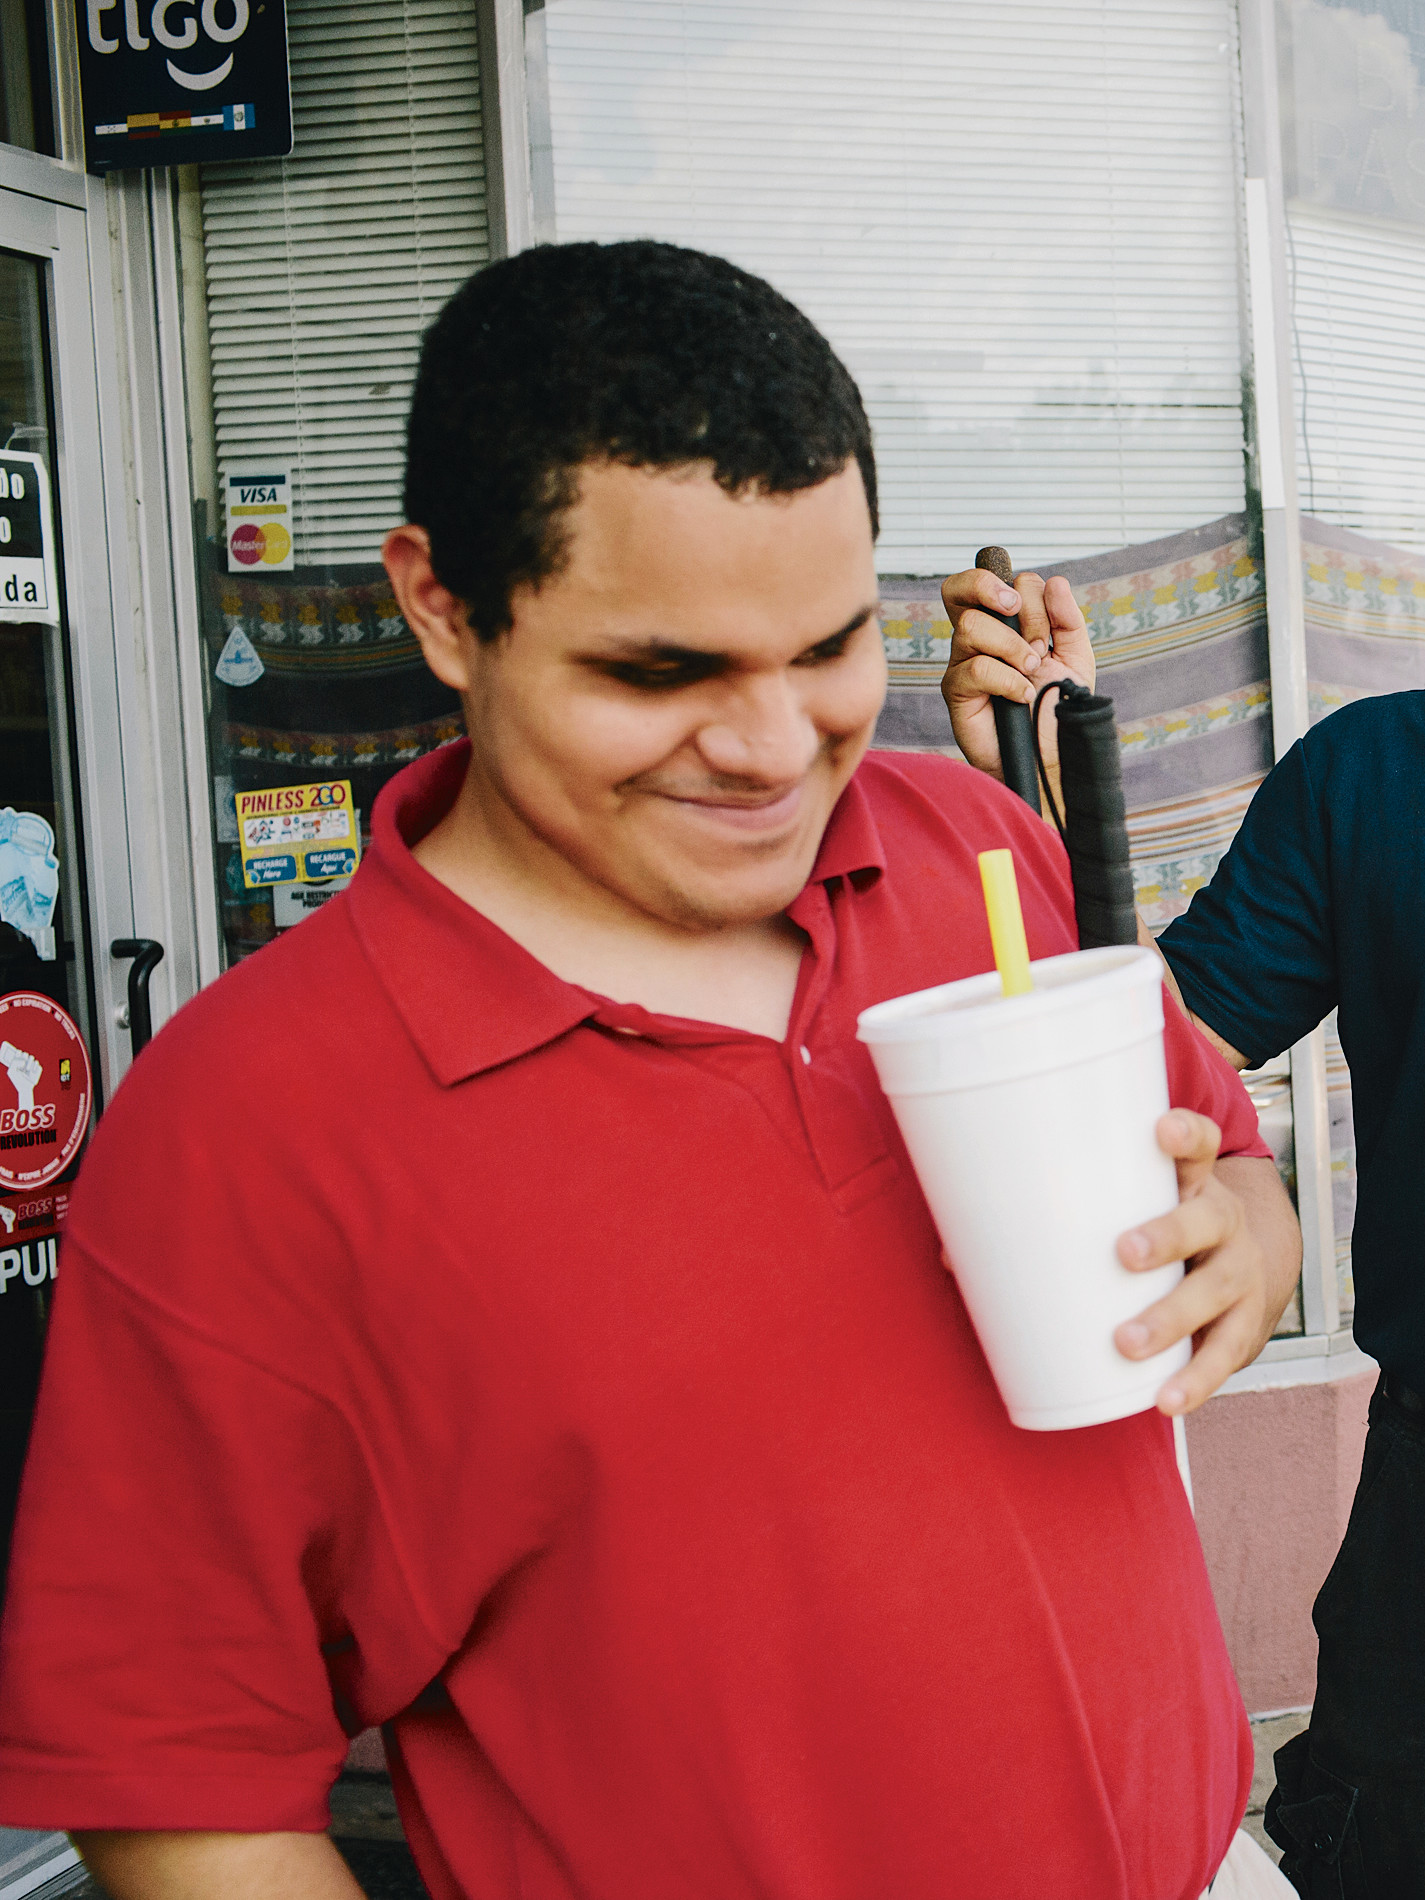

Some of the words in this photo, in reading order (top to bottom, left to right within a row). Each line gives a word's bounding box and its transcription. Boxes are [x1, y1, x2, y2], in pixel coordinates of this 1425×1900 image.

[240, 486, 278, 504] VISA
[0, 573, 39, 602] da
[241, 789, 304, 813] PINLESS
[309, 784, 346, 807] 2GO
[253, 857, 288, 870] RECHARGE
[0, 1103, 56, 1133] BOSS
[0, 1129, 57, 1150] REVOLUTION
[17, 1197, 53, 1220] BOSS
